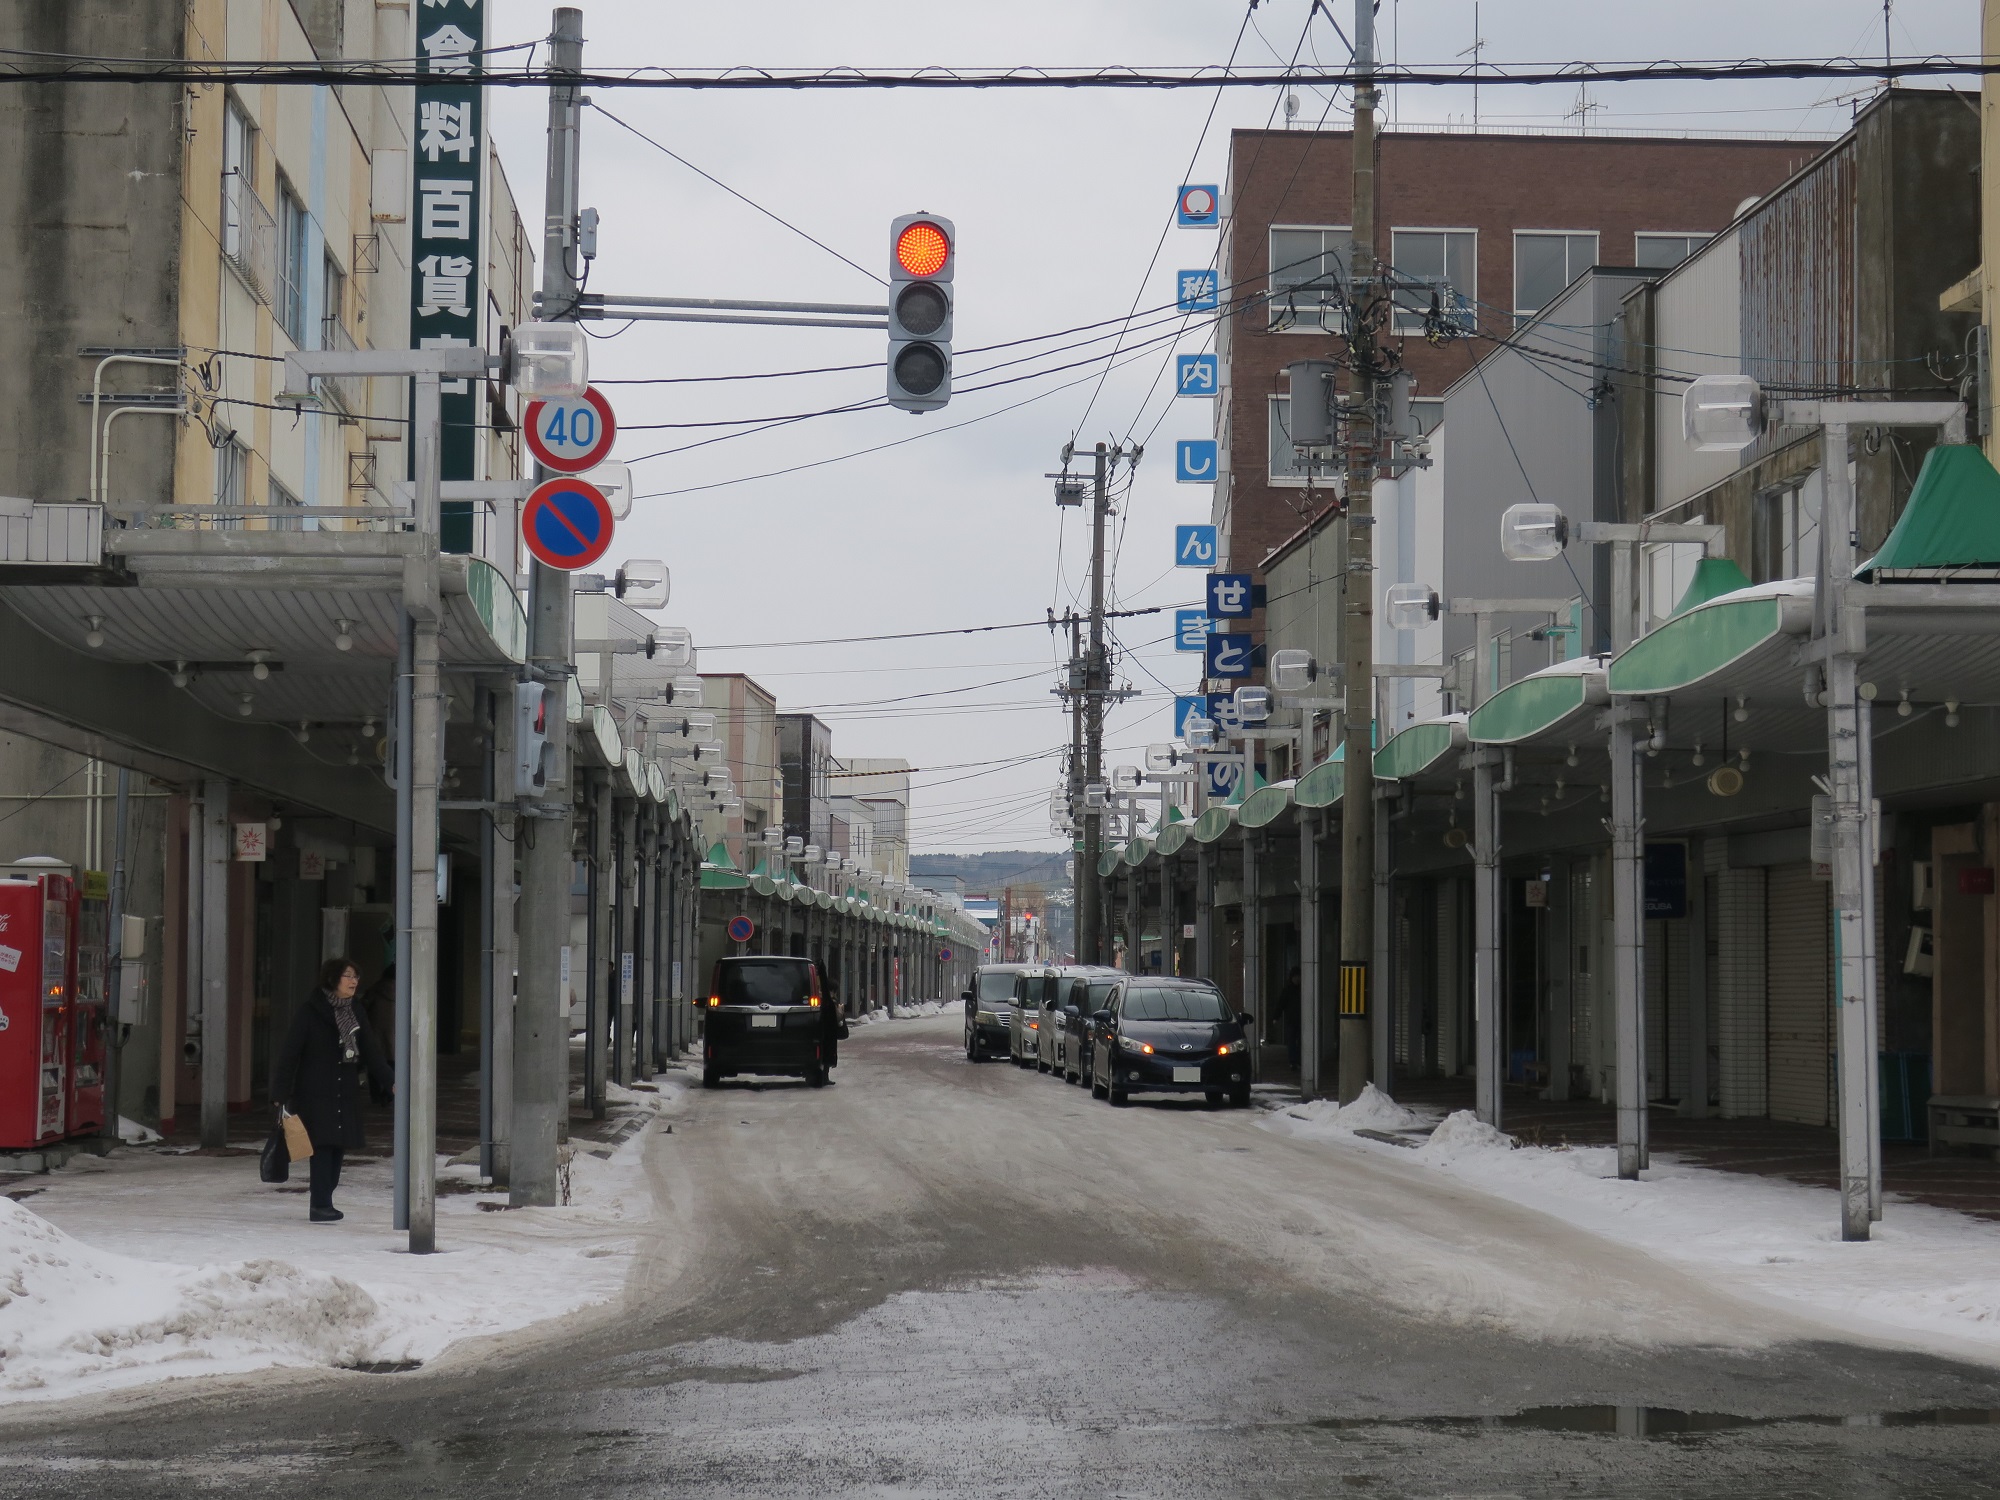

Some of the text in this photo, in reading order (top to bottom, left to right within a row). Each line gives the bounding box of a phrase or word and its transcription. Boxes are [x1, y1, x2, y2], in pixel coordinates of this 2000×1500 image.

[417, 0, 478, 395] 食料百貨
[544, 406, 594, 447] 40
[1212, 579, 1247, 789] せともの
